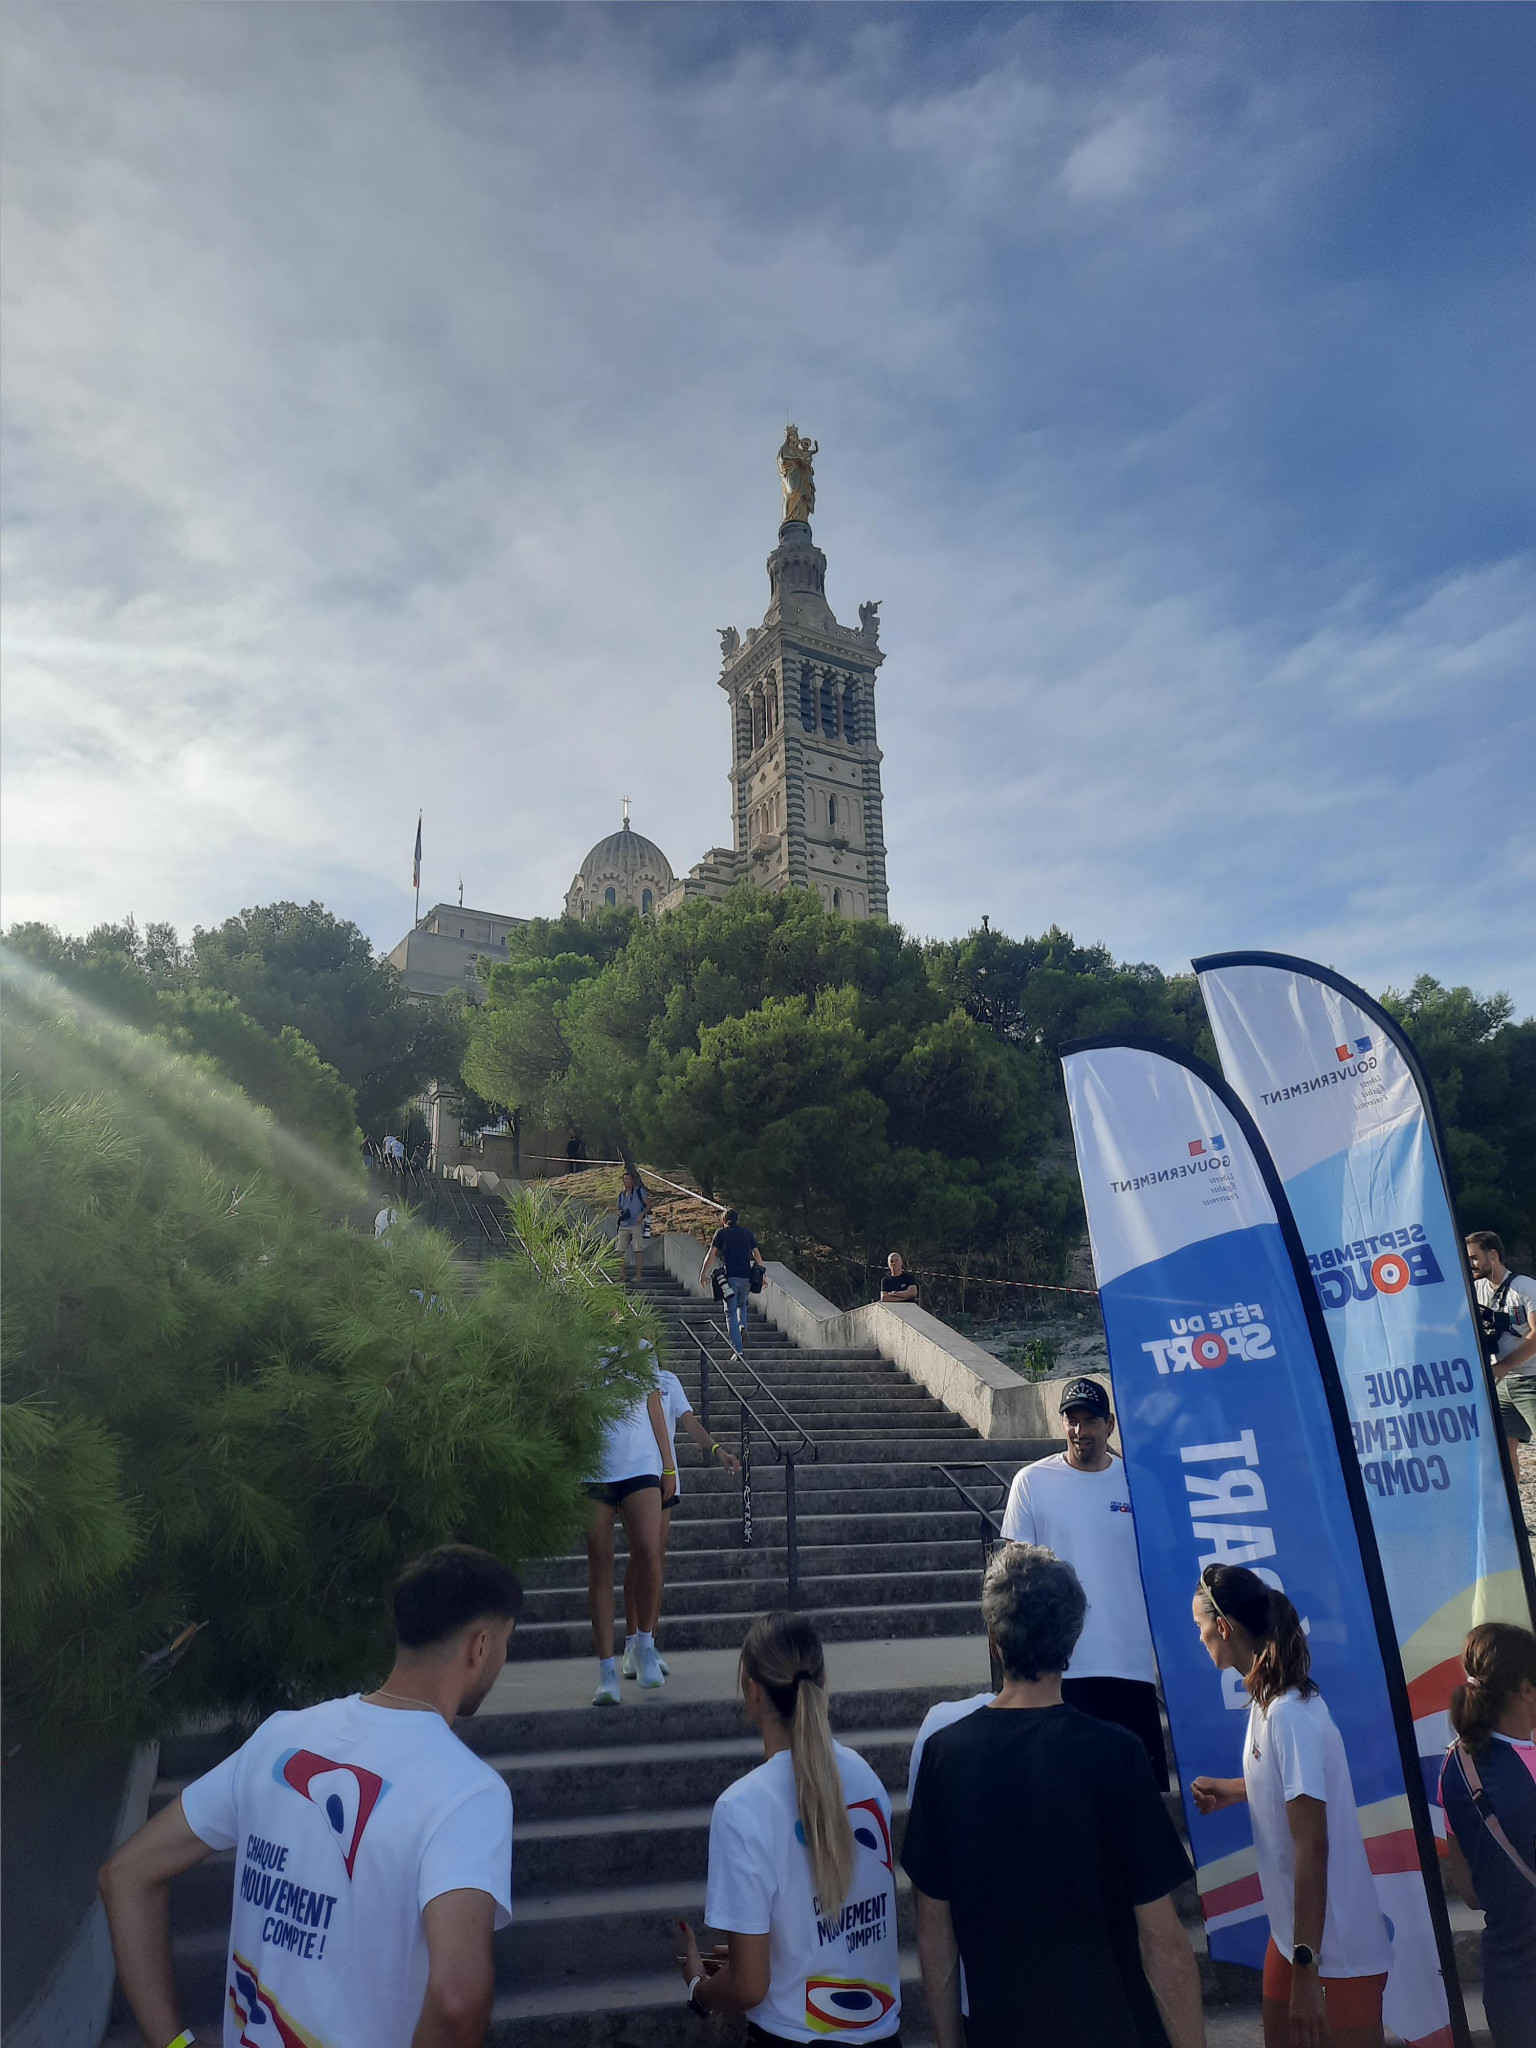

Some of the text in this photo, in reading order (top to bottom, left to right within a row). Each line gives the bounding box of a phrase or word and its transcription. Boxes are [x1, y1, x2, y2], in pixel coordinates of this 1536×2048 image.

[246, 1833, 289, 1873] CHAQUE
[240, 1863, 338, 1931] MOUVEMENT
[262, 1916, 318, 1960] COMPTE
[845, 1922, 882, 1954] COMPTE
